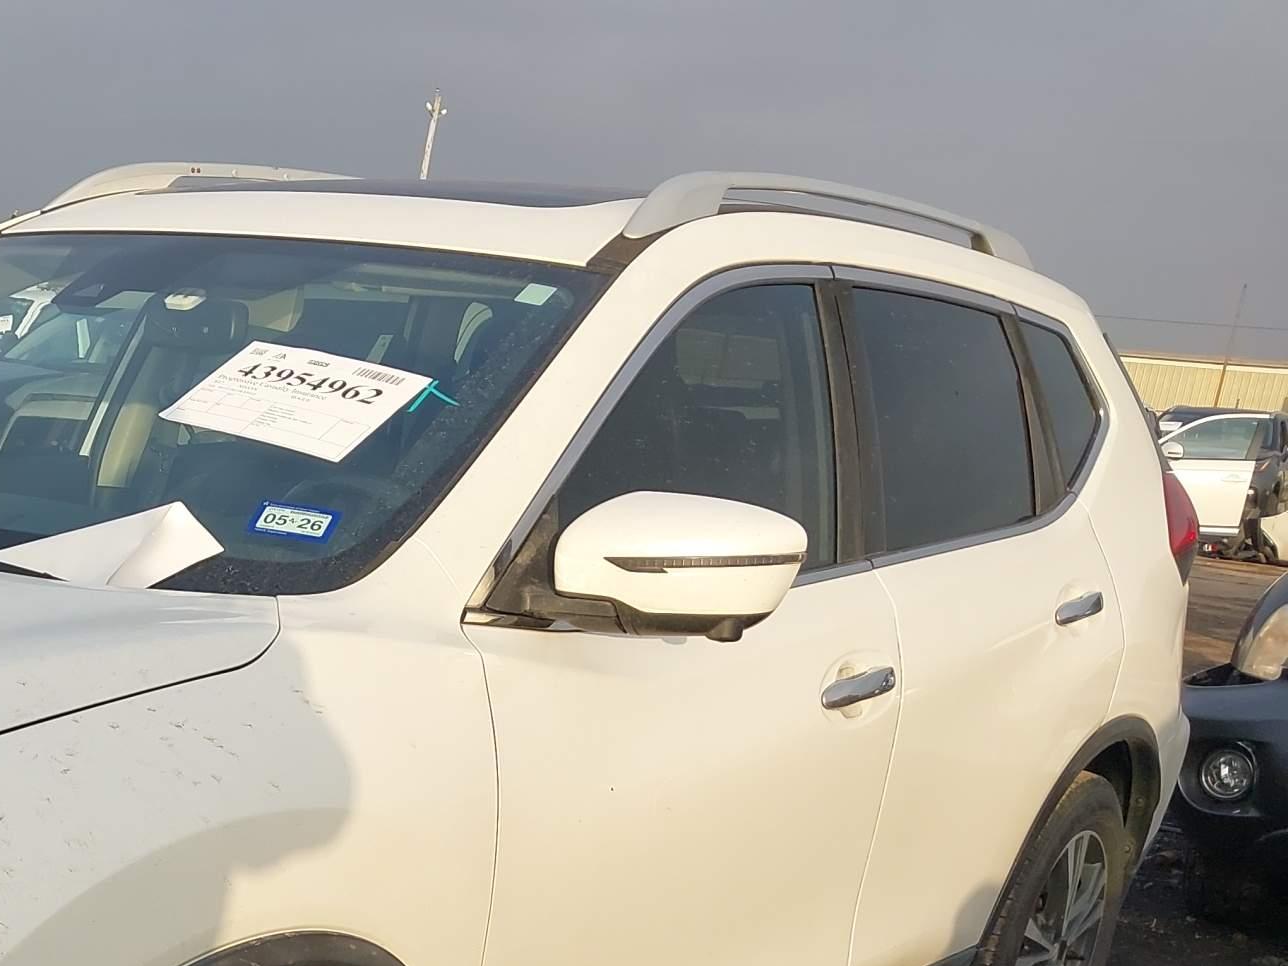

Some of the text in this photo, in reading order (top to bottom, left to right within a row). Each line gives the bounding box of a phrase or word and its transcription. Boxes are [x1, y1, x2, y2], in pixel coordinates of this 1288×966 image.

[237, 363, 383, 404] 43954962
[263, 512, 289, 526] 05
[297, 517, 324, 532] 26
